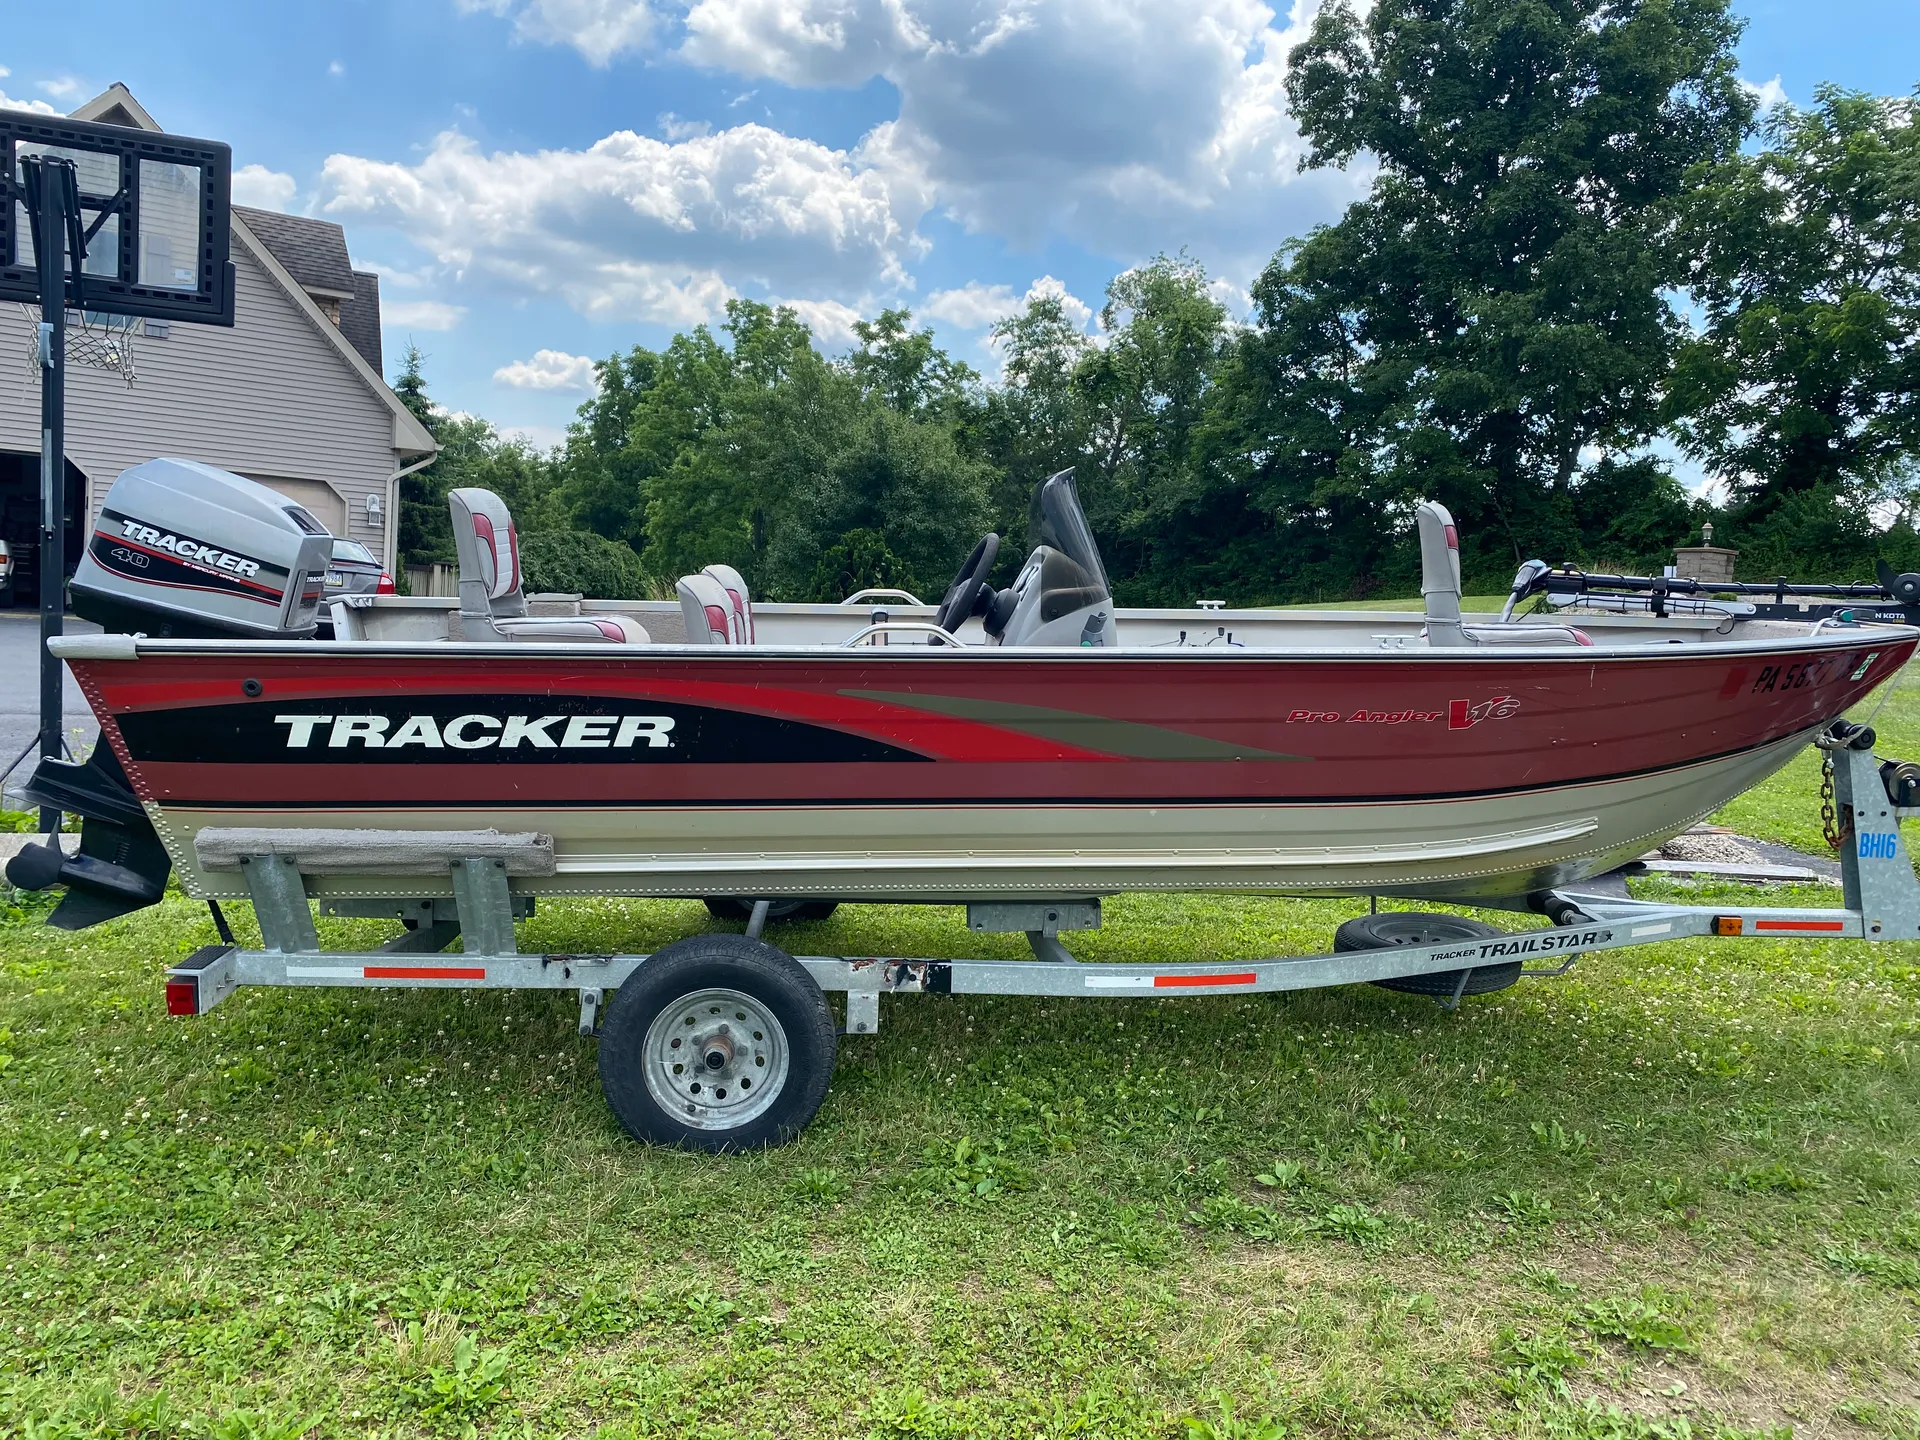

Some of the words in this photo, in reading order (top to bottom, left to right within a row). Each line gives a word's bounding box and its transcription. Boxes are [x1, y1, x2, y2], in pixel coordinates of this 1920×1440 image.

[110, 547, 150, 569] 40
[121, 519, 260, 578] TRACKER
[191, 564, 218, 576] MERCURY
[218, 573, 241, 583] MARINE
[1751, 665, 1781, 694] PA
[1286, 709, 1340, 723] Pro
[1346, 709, 1444, 724] Angler
[274, 714, 676, 749] TRACKER
[1430, 949, 1476, 961] TRACKER
[1478, 931, 1598, 959] TRAILSTAR
